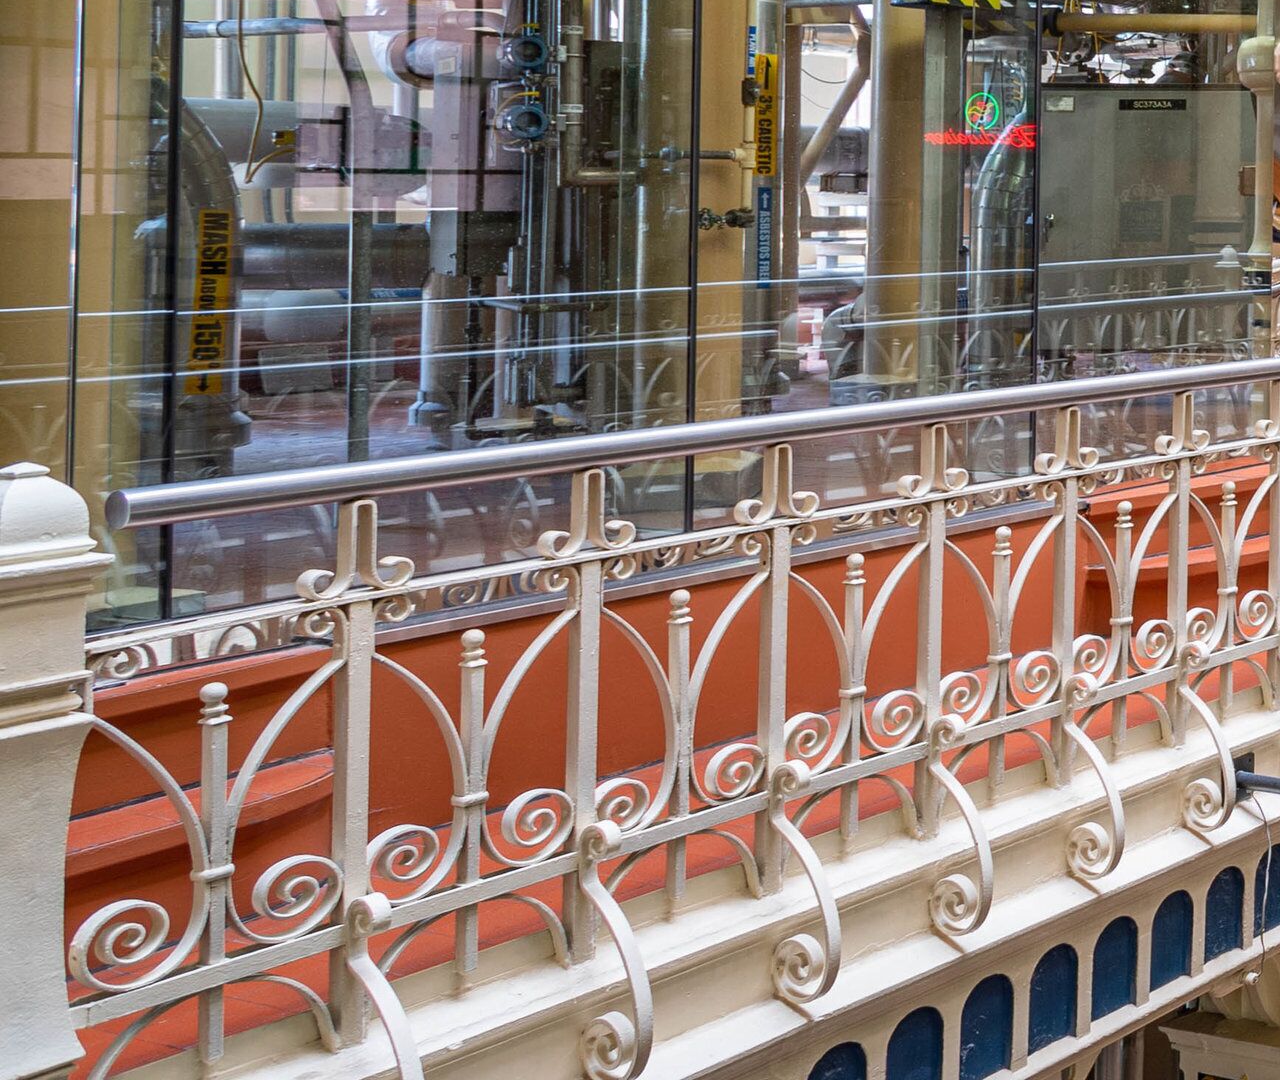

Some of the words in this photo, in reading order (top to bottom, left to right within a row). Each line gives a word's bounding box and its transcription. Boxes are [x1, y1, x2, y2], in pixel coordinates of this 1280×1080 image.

[758, 95, 773, 117] 3%
[758, 118, 772, 176] CAUSTIC
[200, 212, 230, 275] MASH
[758, 210, 772, 260] ASBESTOS
